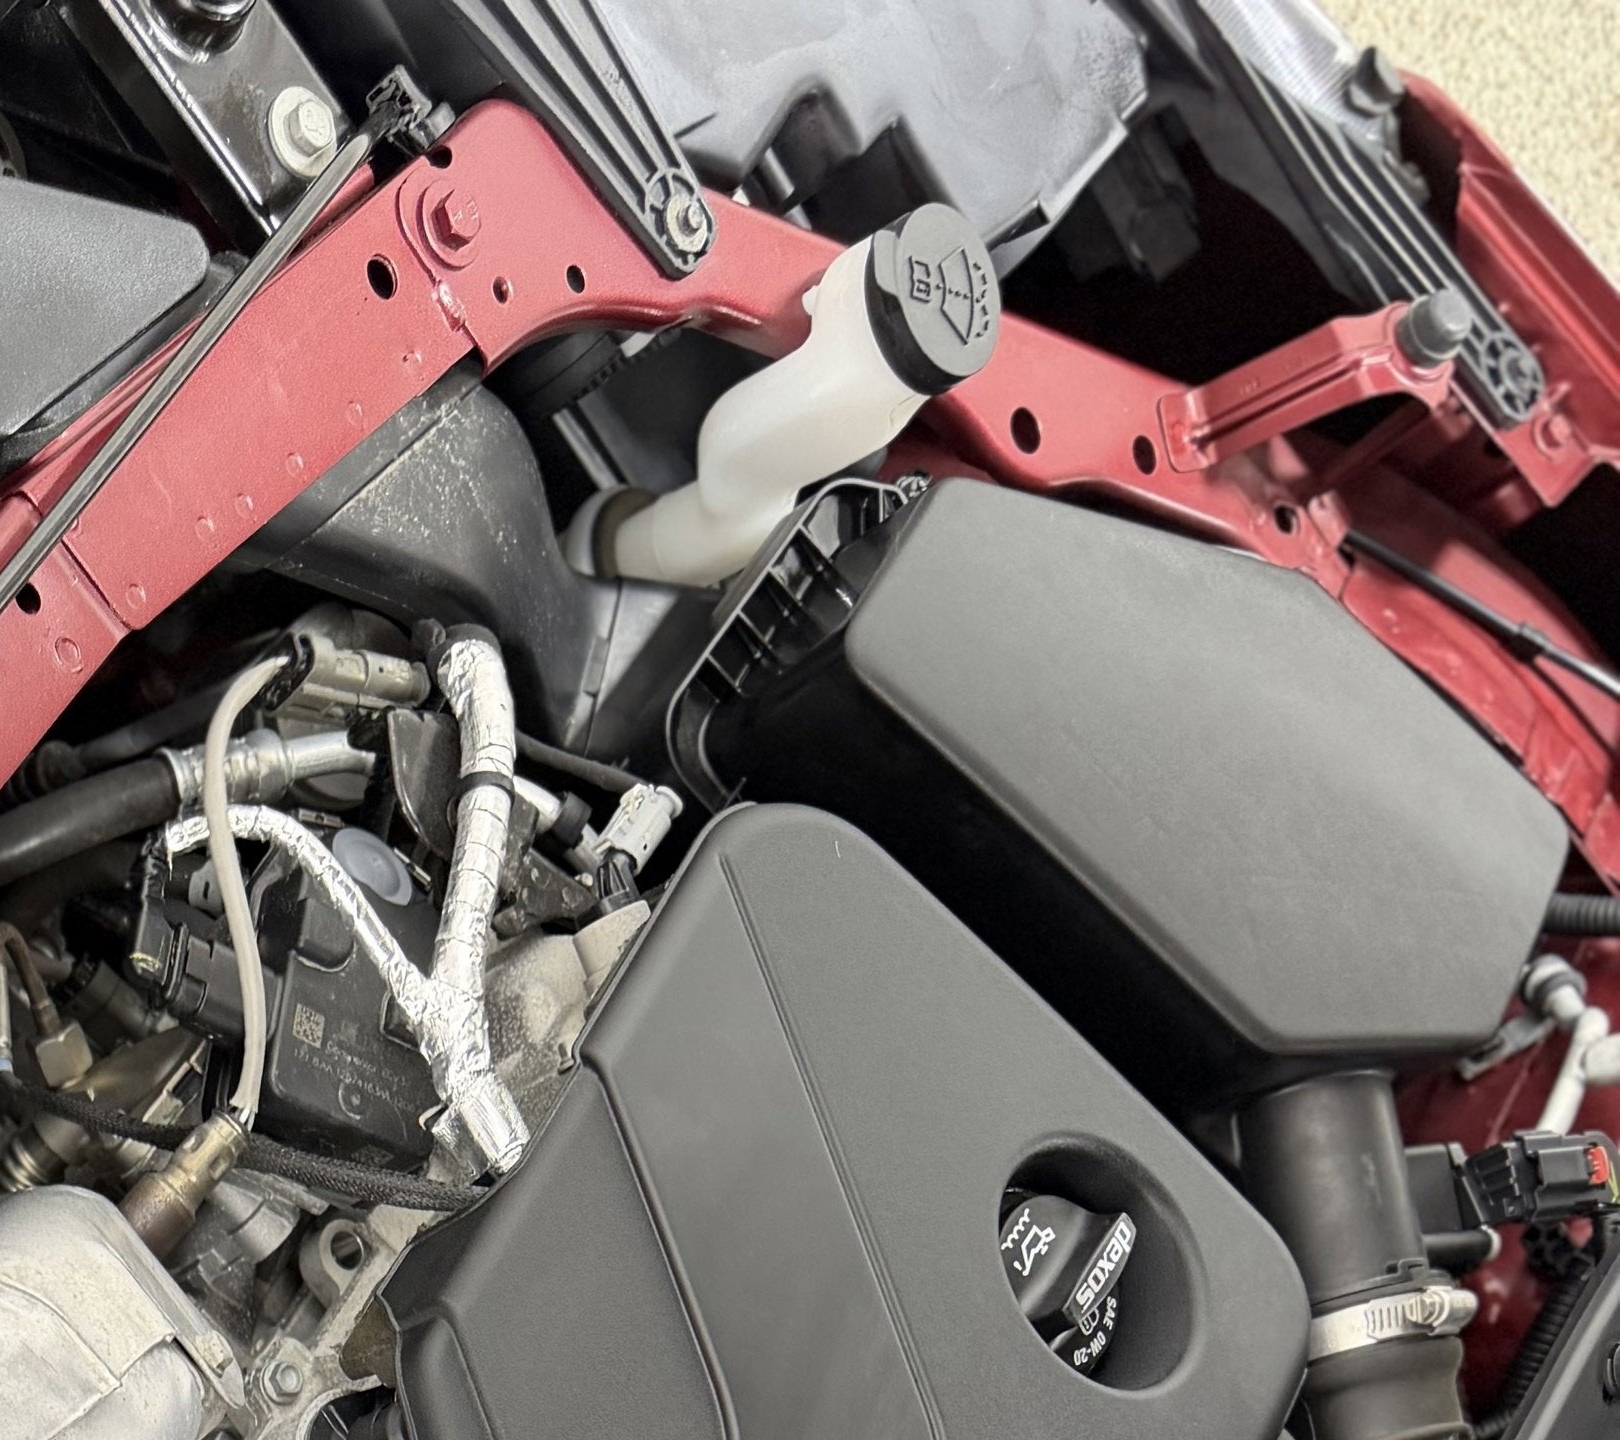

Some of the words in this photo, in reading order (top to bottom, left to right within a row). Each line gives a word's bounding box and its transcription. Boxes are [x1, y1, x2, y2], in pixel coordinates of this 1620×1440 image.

[1075, 1221, 1131, 1314] dexos
[1104, 1296, 1117, 1331] SAE
[1073, 1331, 1106, 1366] 0W-20
